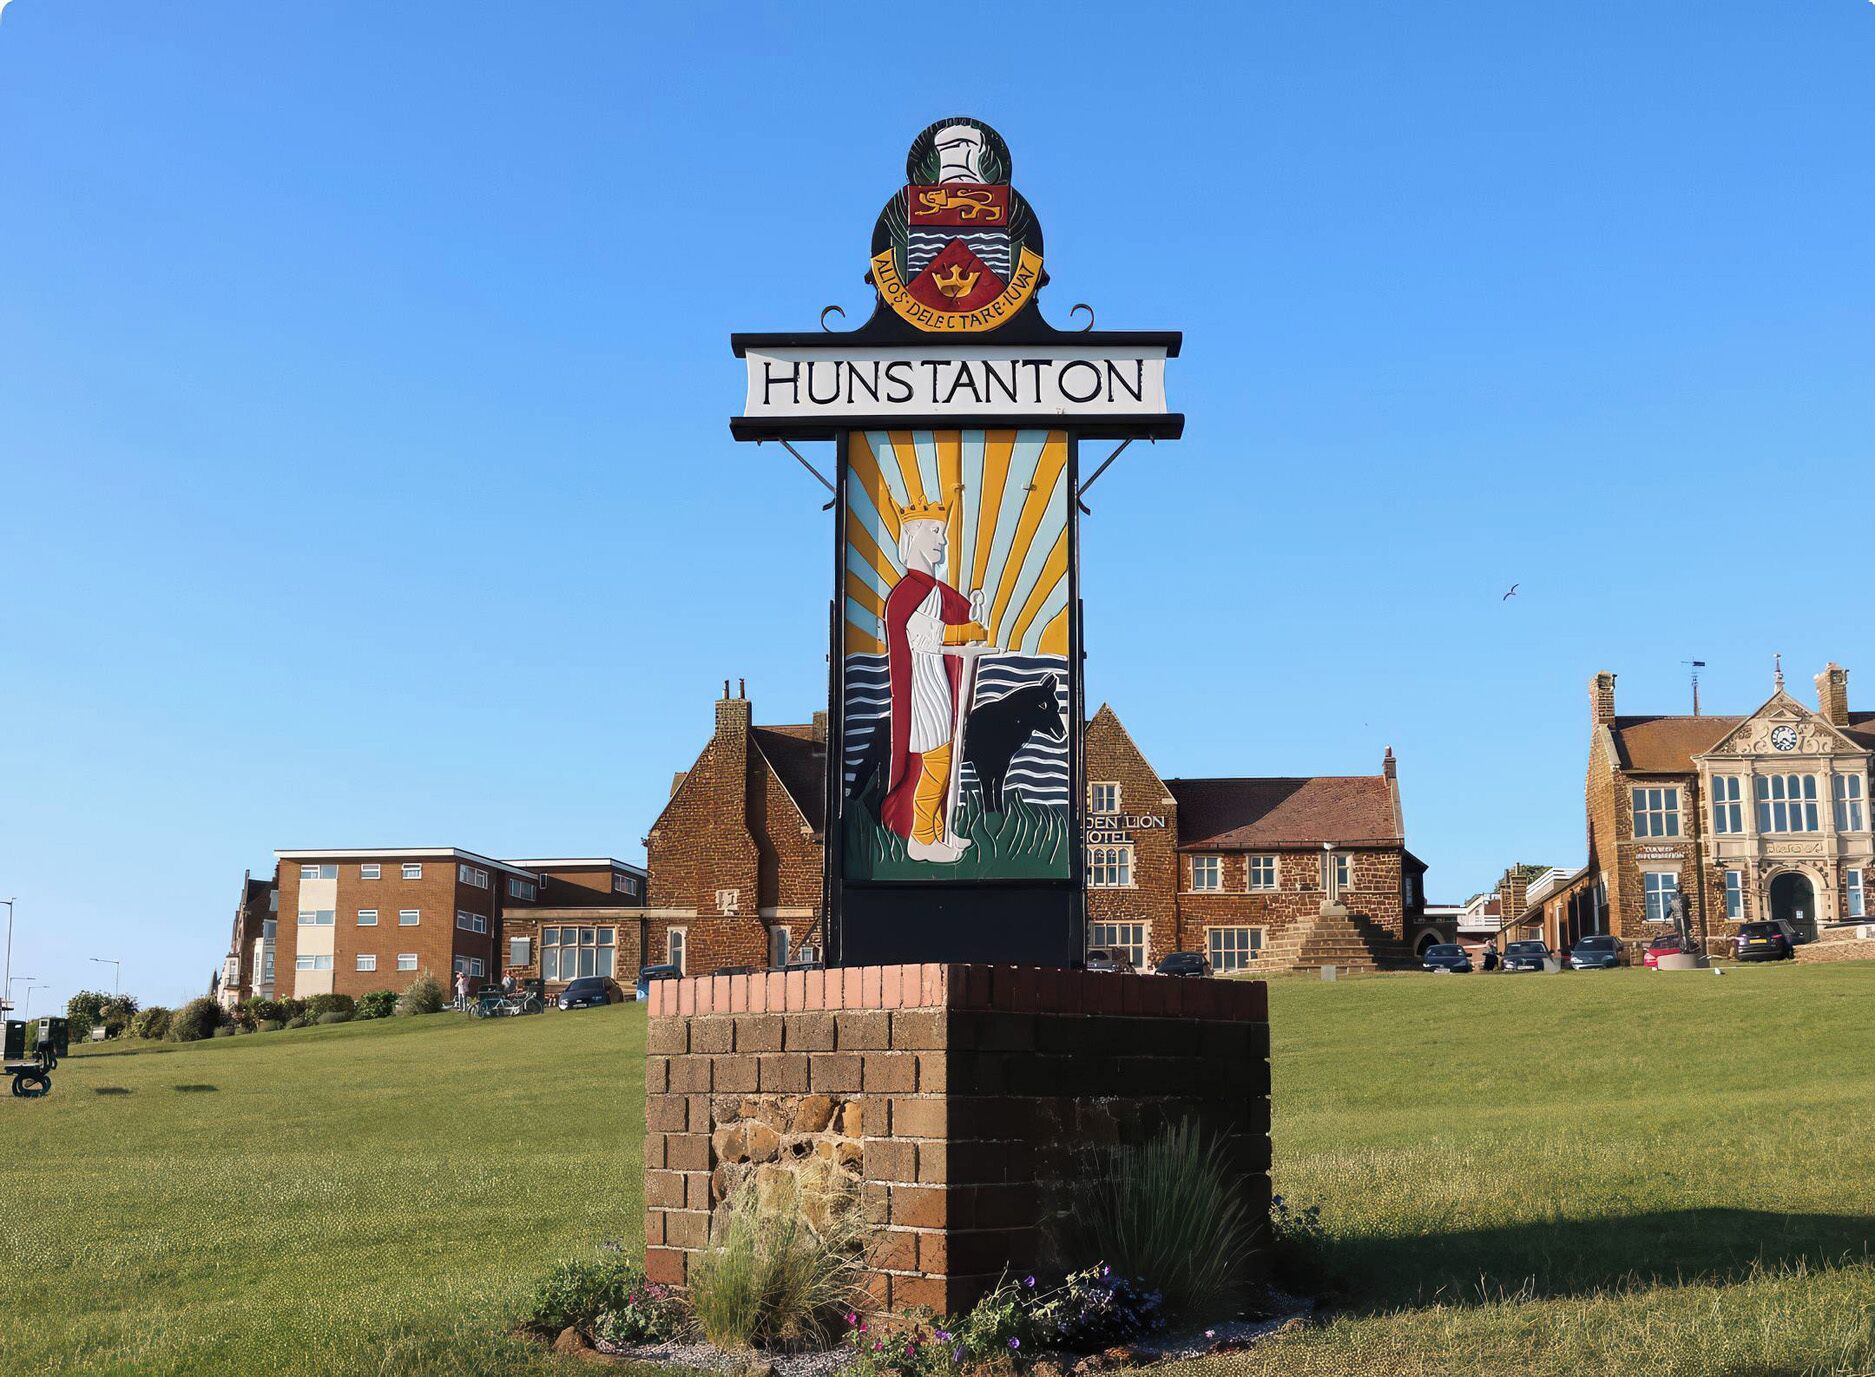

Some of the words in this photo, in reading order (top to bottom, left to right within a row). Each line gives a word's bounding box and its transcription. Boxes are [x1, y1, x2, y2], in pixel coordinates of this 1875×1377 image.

[906, 301, 1004, 329] DELECTARE
[763, 358, 1144, 405] HUNSTANTON
[1086, 815, 1119, 829] DEN
[1124, 815, 1165, 829] LION
